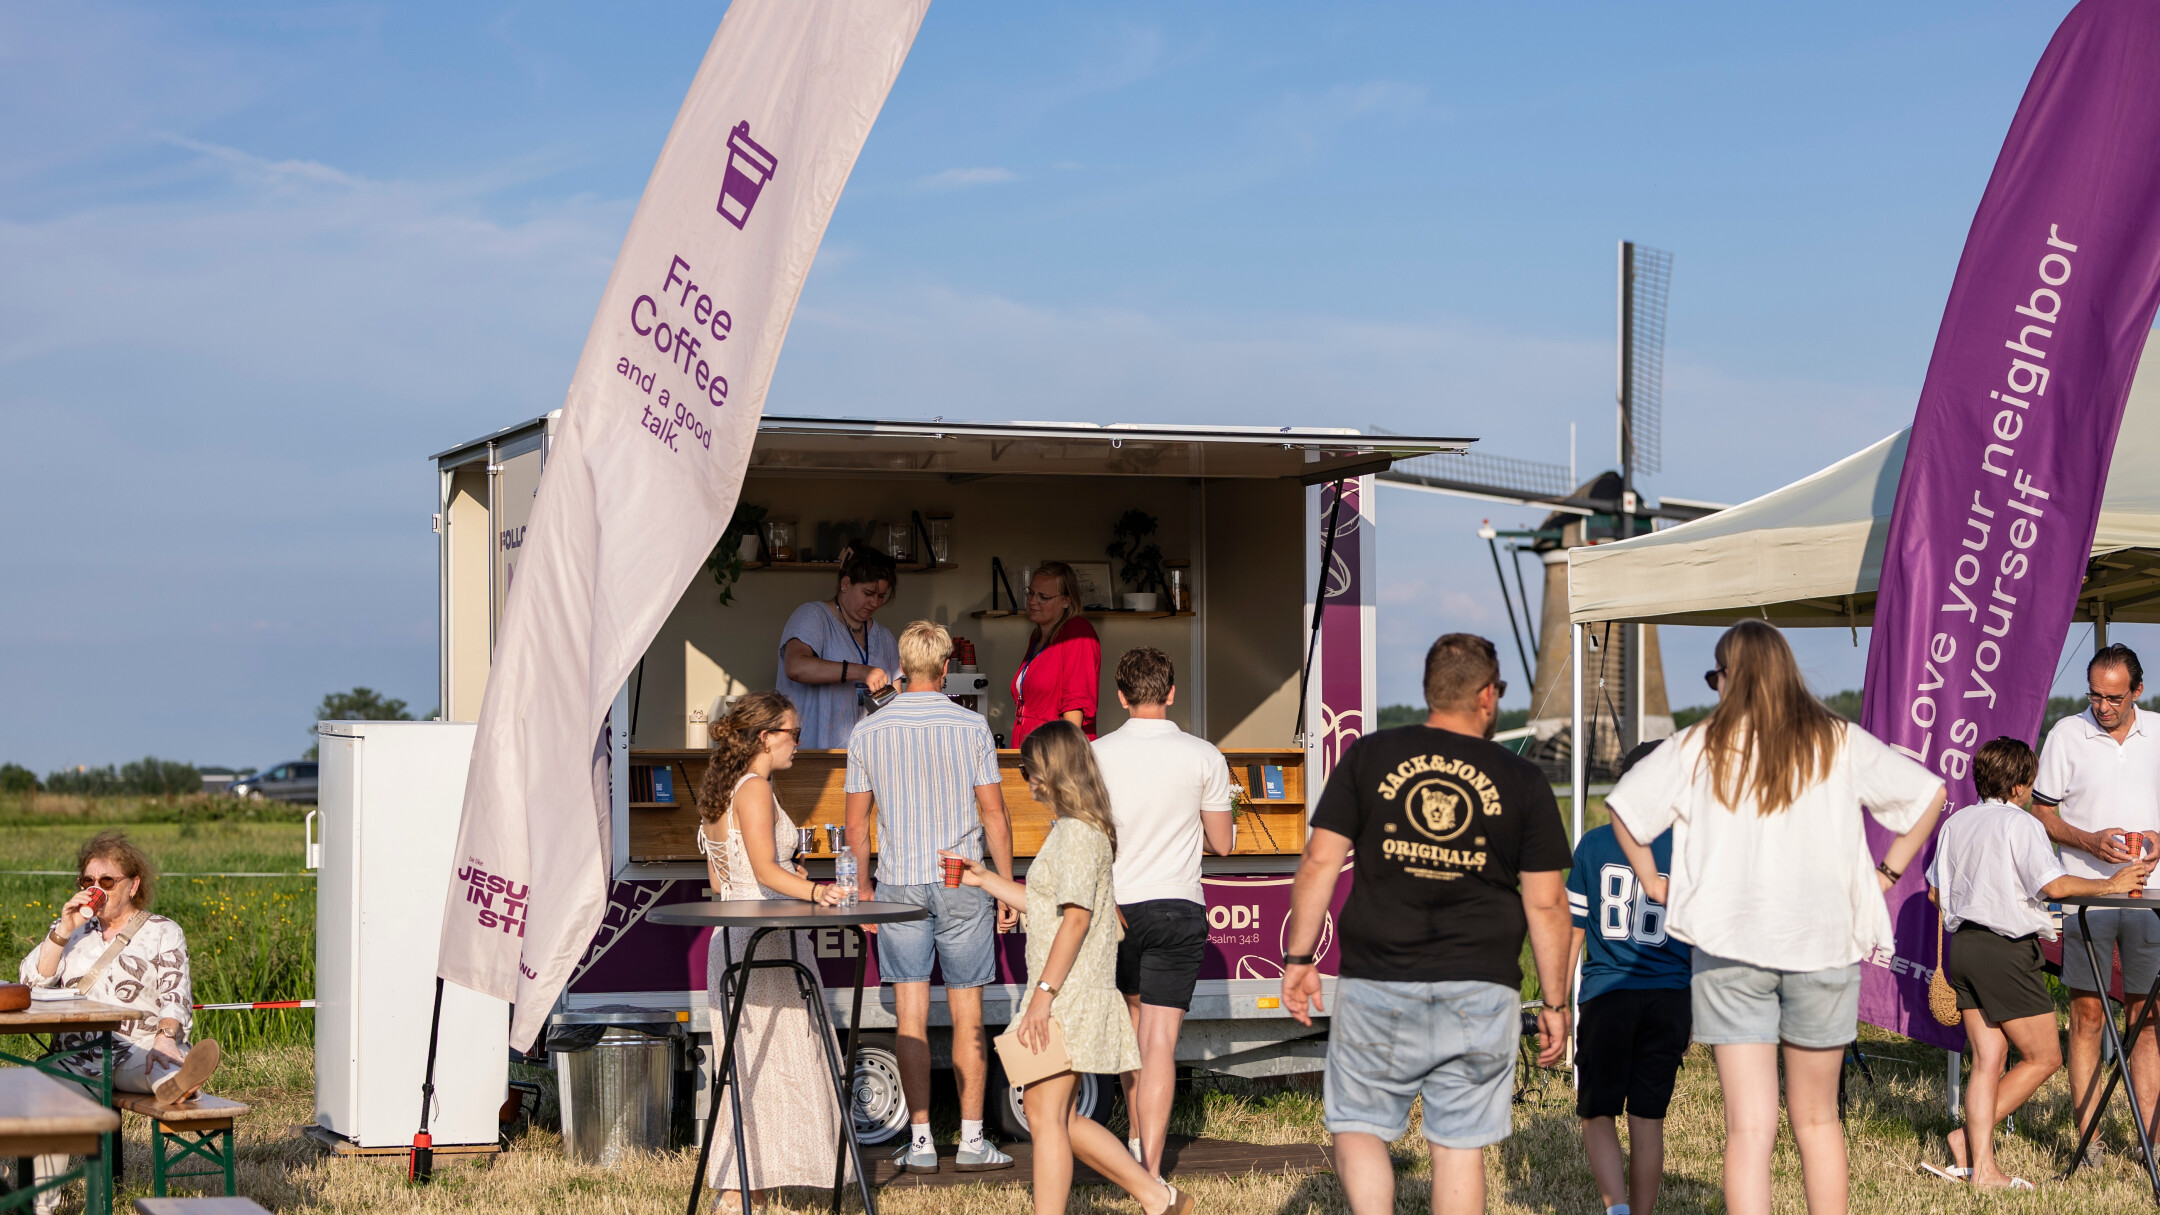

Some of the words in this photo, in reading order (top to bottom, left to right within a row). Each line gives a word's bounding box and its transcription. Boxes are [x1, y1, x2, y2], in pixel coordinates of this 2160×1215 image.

[662, 254, 732, 341] Free
[631, 294, 729, 407] Coffee
[616, 356, 656, 395] and
[658, 388, 671, 408] a
[675, 402, 712, 451] good
[640, 404, 679, 453] talk.
[1890, 632, 1957, 763] Love
[1941, 489, 1995, 624] your
[1981, 223, 2078, 478] neighbor
[1939, 718, 1978, 781] as
[1963, 468, 2050, 710] yourself
[1377, 754, 1502, 816] JACK&JONES
[1382, 838, 1487, 866] ORIGINALS
[458, 865, 530, 900] JESU
[466, 885, 494, 909] IN
[1205, 933, 1237, 944] Psalm
[1239, 933, 1260, 945] 34:8
[1206, 904, 1260, 930] OD!
